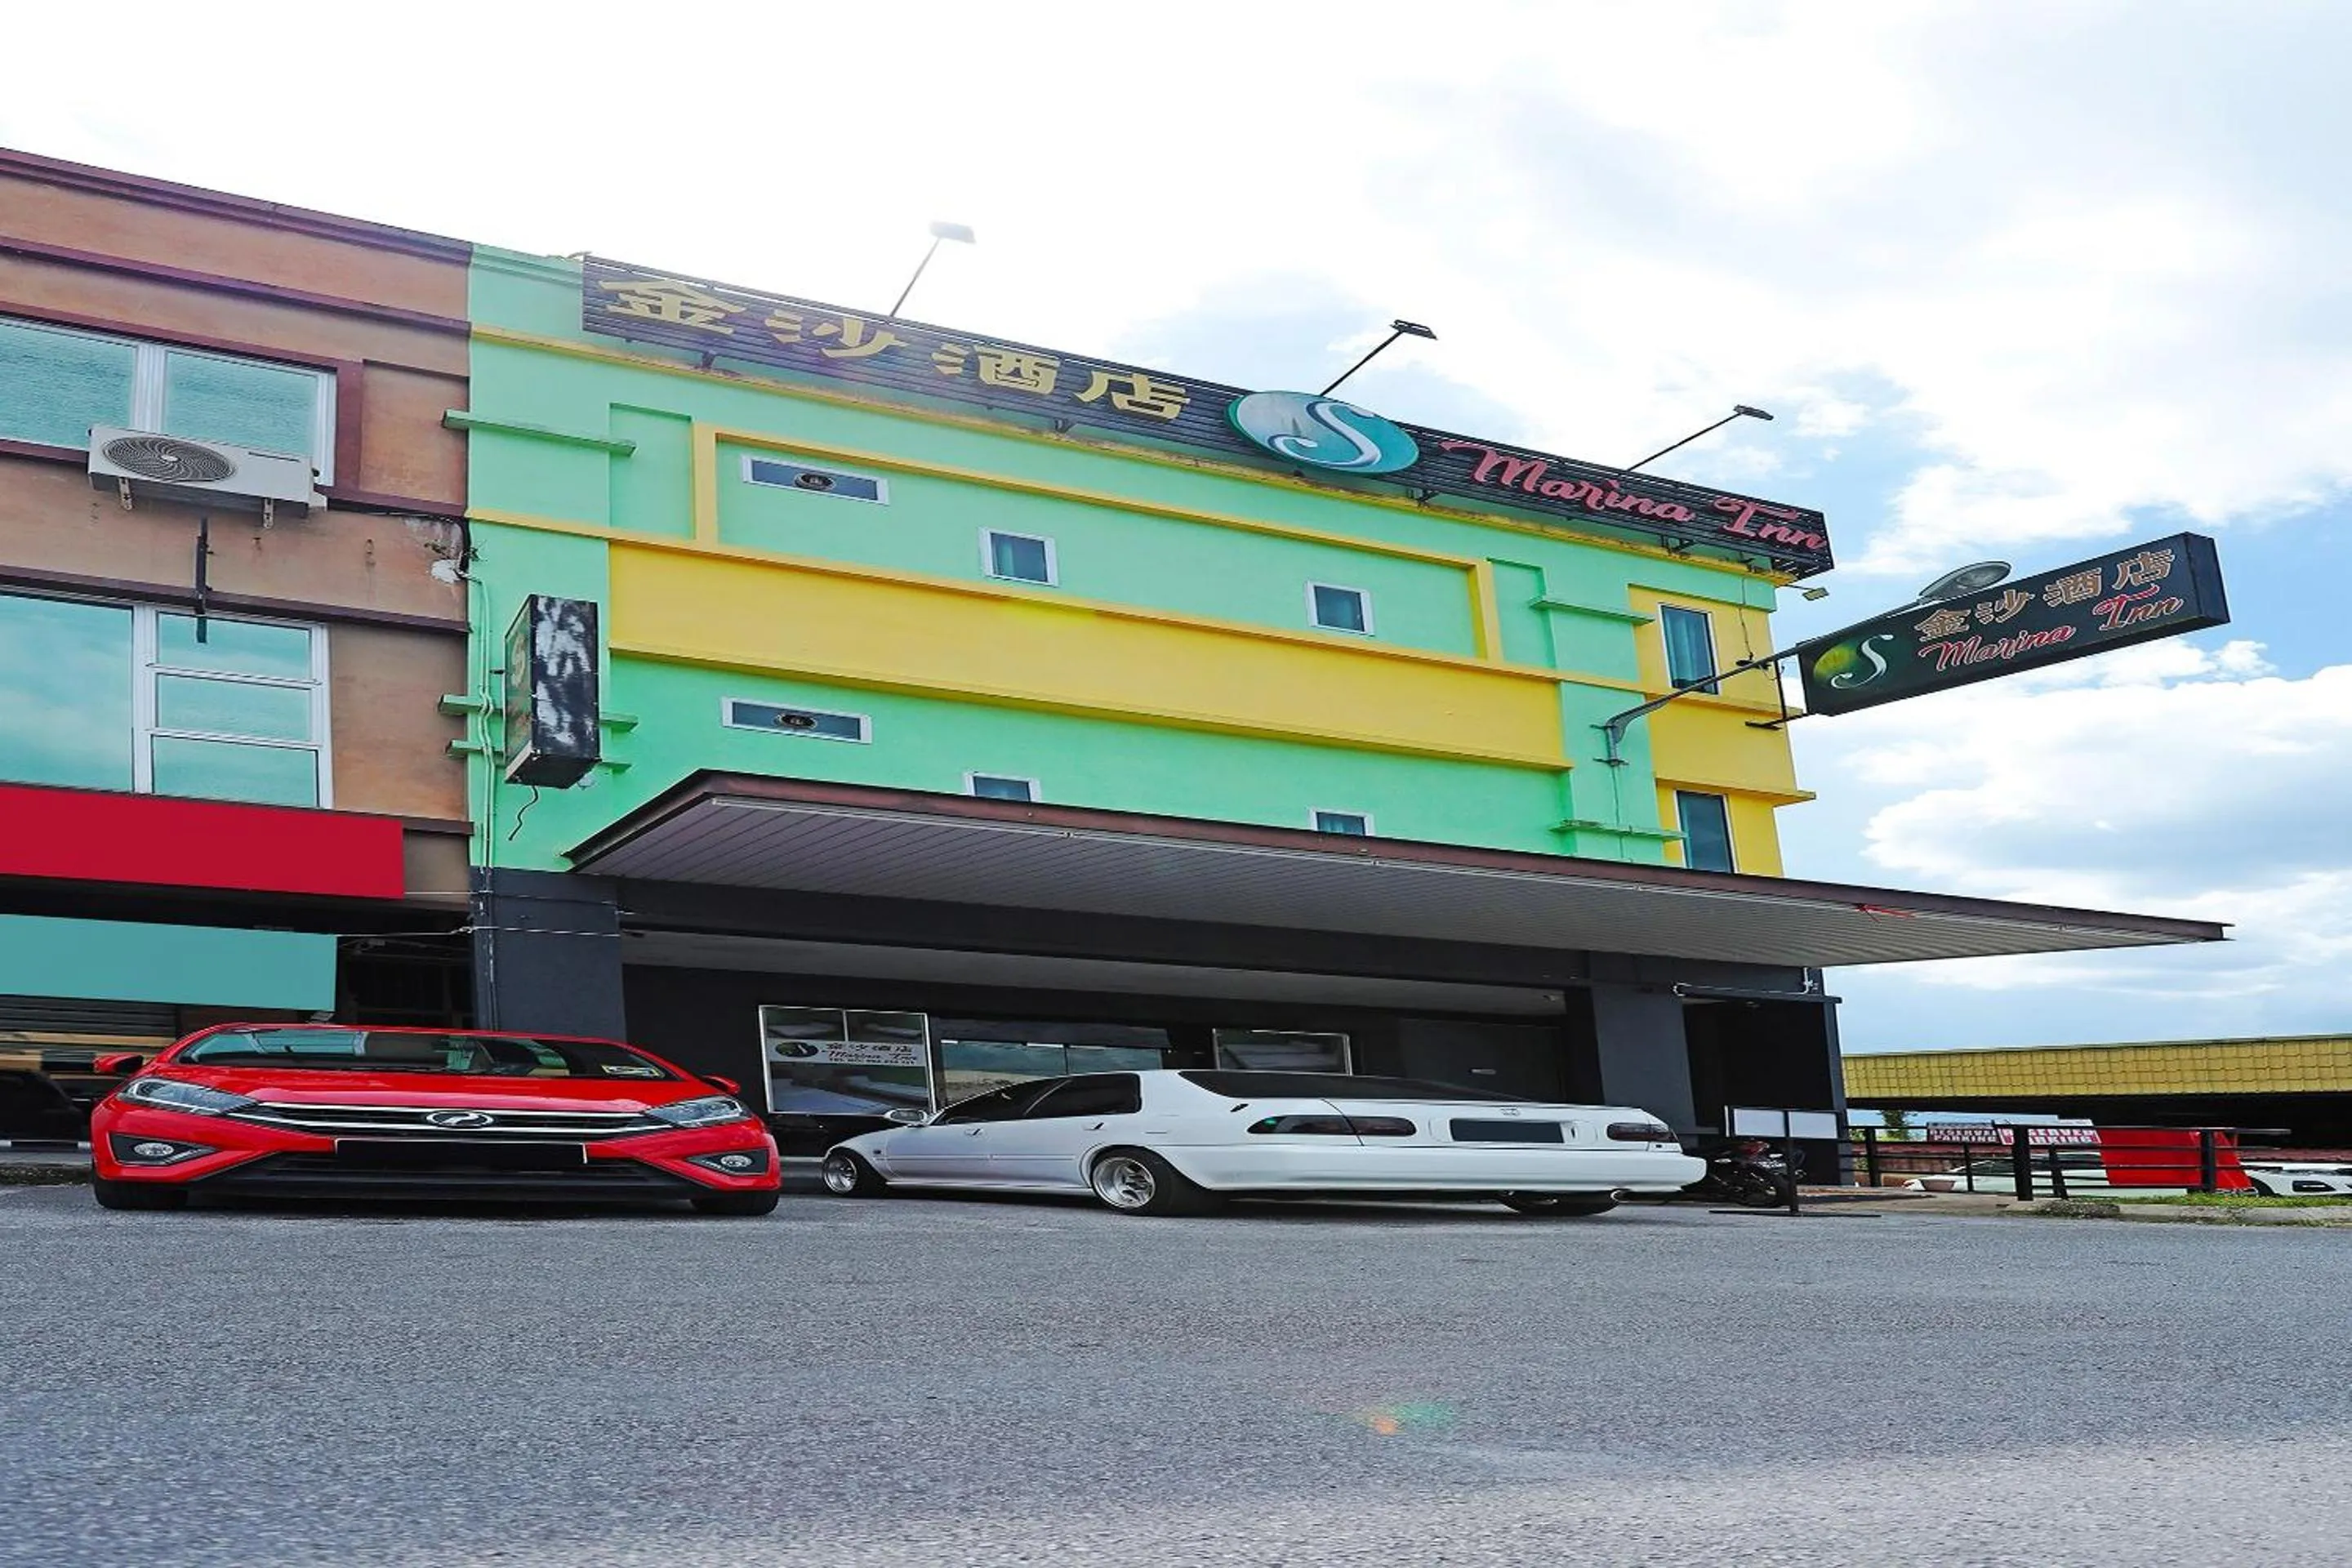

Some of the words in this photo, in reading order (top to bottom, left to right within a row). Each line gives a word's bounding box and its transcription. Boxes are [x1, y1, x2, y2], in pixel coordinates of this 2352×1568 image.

[598, 279, 1191, 422] 金沙酒店
[1437, 439, 1696, 523] Marina
[1714, 498, 1829, 551] Inn
[1914, 548, 2176, 642] 金沙酒店
[1918, 625, 2077, 672] Marina
[2092, 583, 2185, 631] Inn
